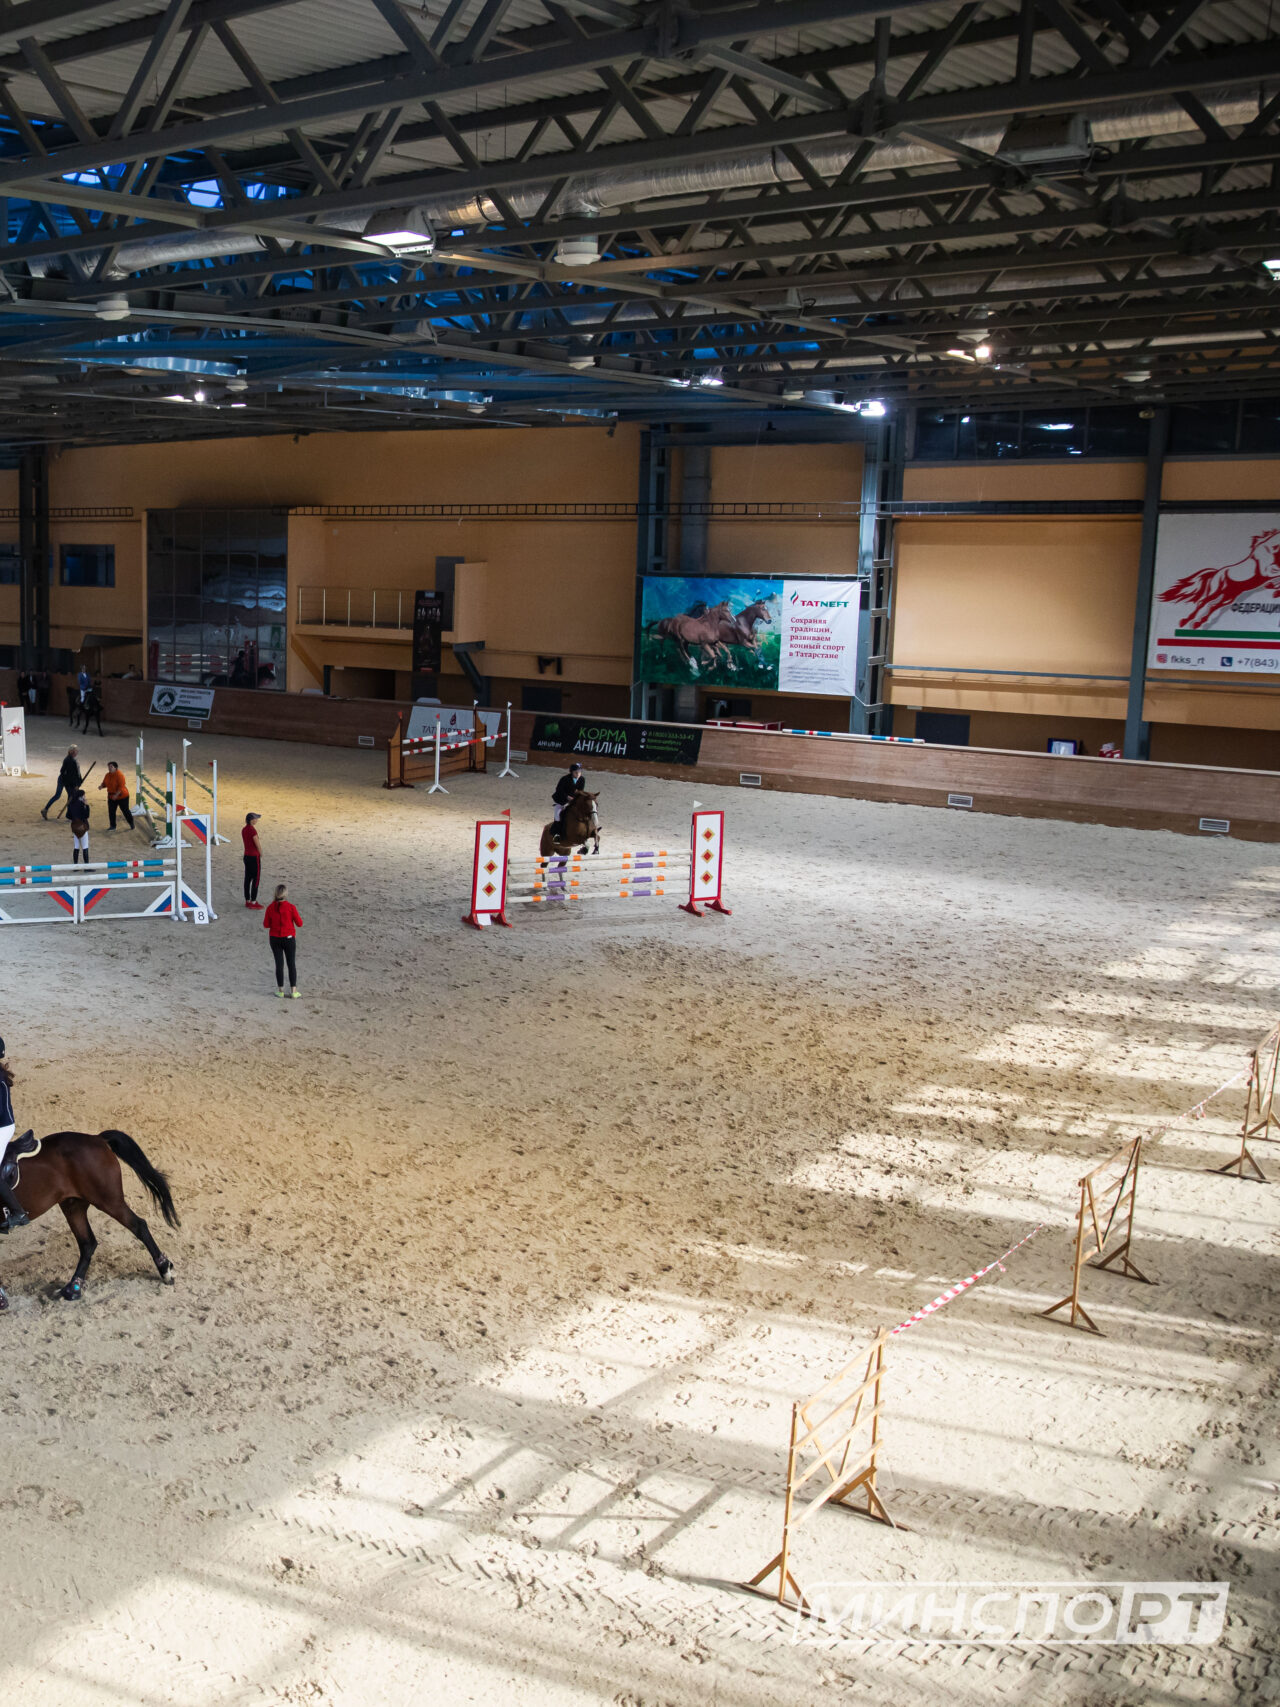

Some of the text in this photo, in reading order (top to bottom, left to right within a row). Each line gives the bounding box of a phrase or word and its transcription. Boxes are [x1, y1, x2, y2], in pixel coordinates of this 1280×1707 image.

[800, 600, 849, 608] TATNEFT
[790, 617, 827, 625] Сохраняя
[790, 626, 833, 634] традиции,
[789, 634, 831, 642] развиваем
[789, 642, 846, 652] конный спорт
[795, 651, 839, 659] Татарстане
[1171, 654, 1205, 666] fkks_rt
[1237, 657, 1279, 668] +7(843)
[578, 727, 627, 742] КОРМА
[537, 740, 562, 748] АНИЛИН
[573, 739, 627, 756] АНИЛИН
[198, 911, 205, 921] 8
